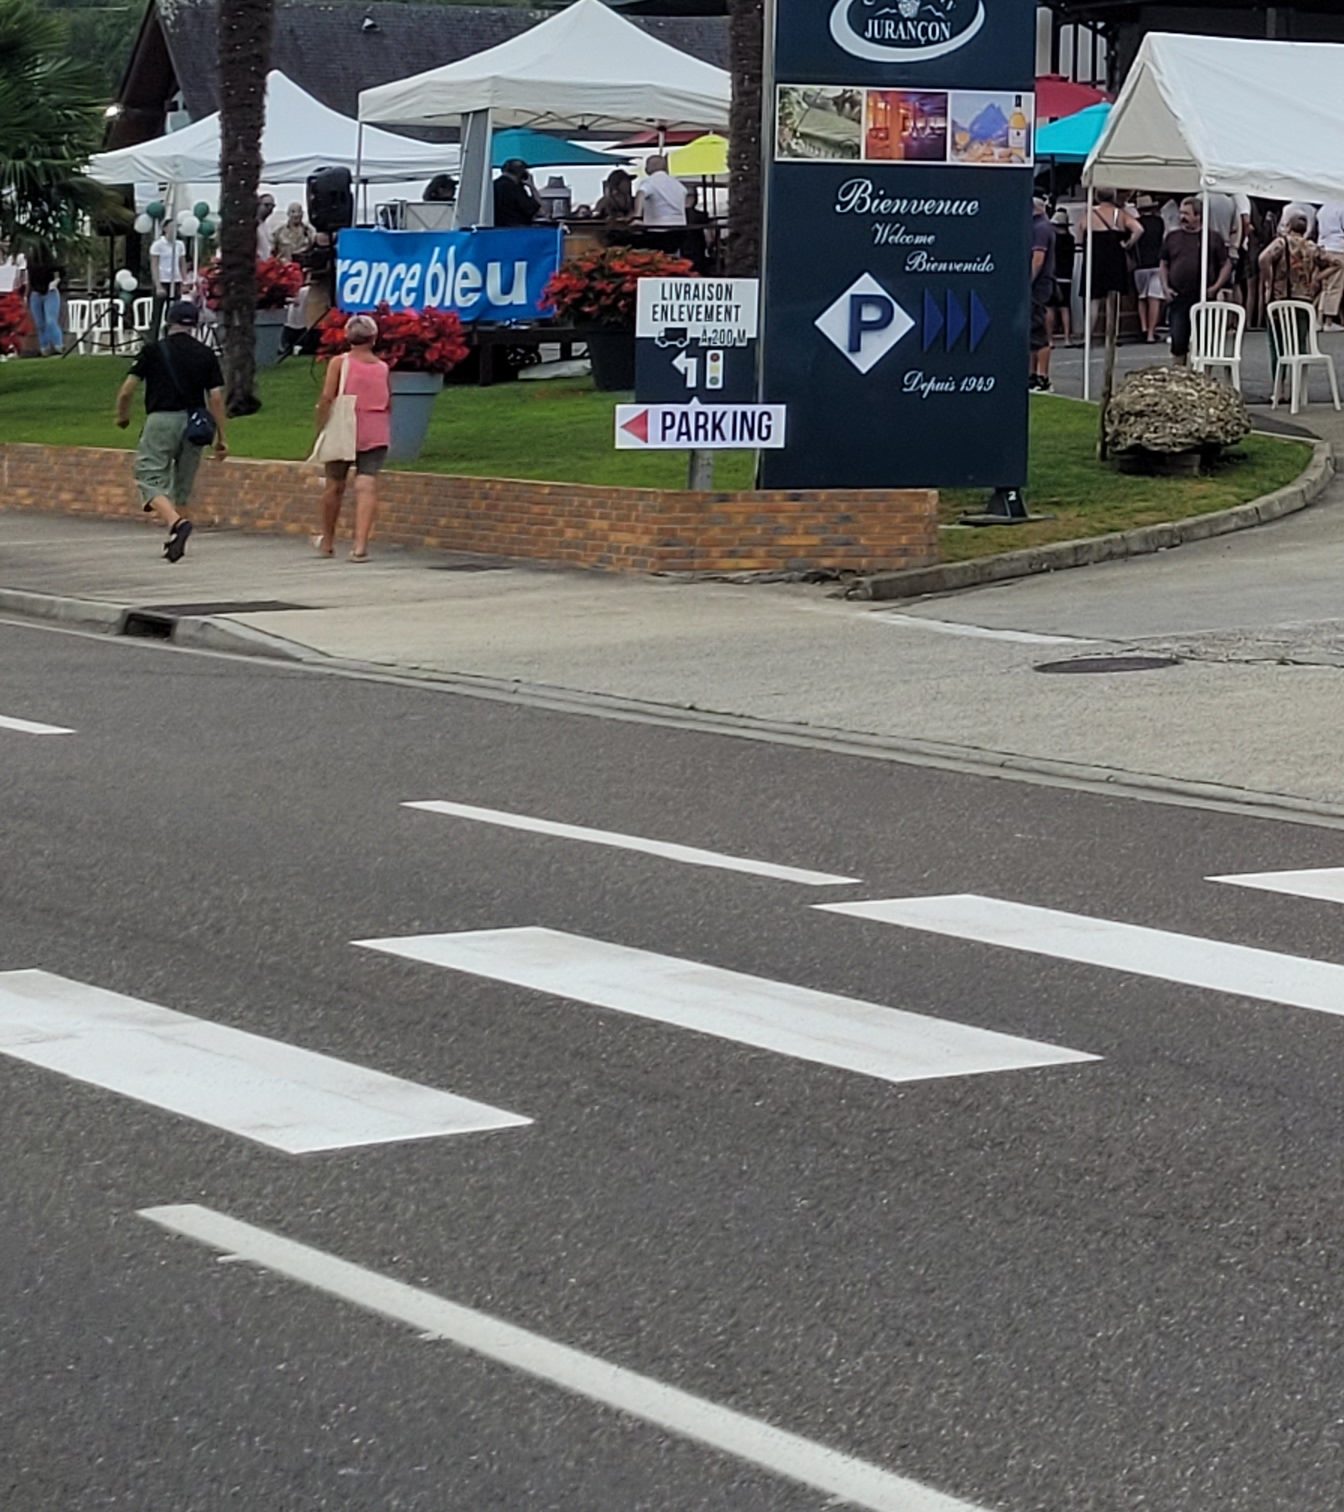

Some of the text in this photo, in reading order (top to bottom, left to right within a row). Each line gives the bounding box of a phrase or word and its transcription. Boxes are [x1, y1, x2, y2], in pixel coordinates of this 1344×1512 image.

[864, 18, 951, 45] JURANÇON
[835, 178, 979, 216] Bienvenue
[871, 222, 936, 245] Welcome
[905, 250, 995, 272] Bienvenido
[424, 245, 527, 306] bleu
[661, 283, 733, 301] LIVRAISON
[652, 304, 741, 322] ENLEVEMENT
[711, 329, 733, 345] 200
[736, 330, 747, 345] M
[902, 370, 996, 399] Depuis 1949
[660, 410, 773, 442] PARKING
